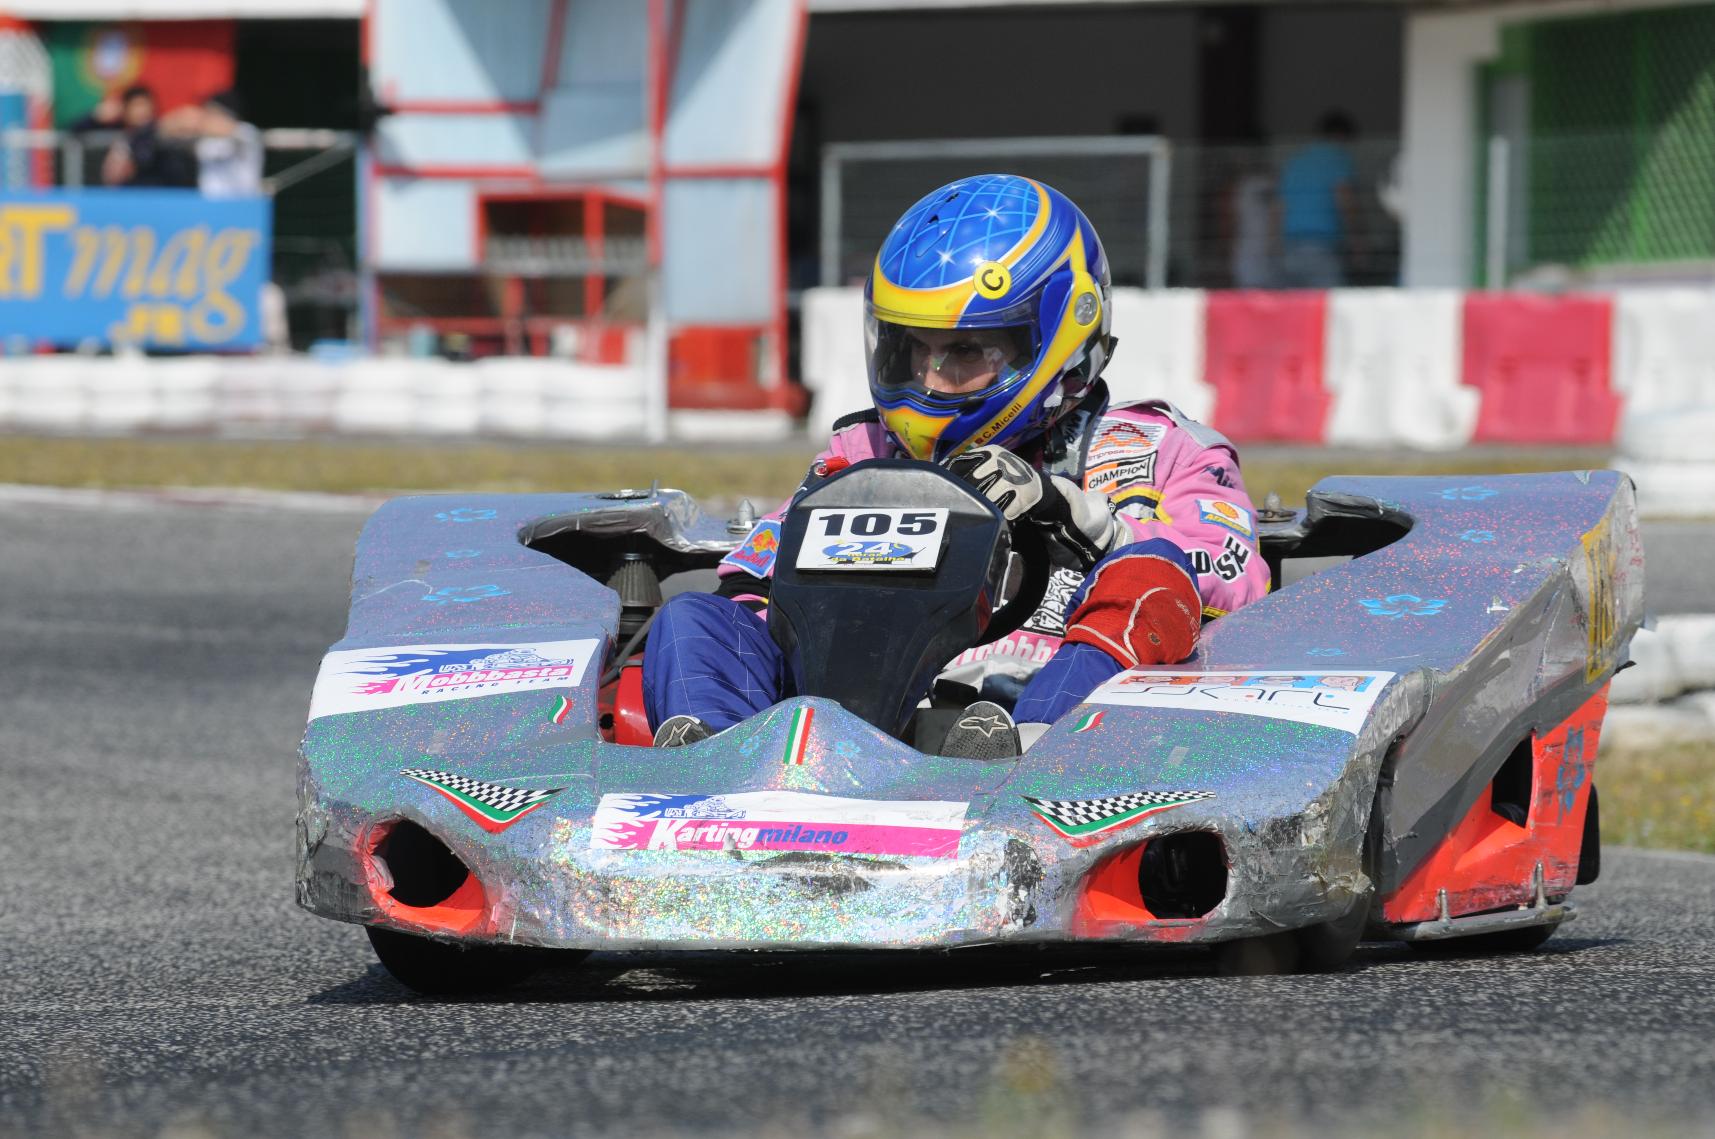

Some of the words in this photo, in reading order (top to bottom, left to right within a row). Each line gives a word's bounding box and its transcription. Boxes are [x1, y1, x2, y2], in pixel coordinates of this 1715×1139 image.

[981, 269, 1004, 291] C
[1088, 462, 1147, 489] CHAMPION
[818, 513, 937, 536] 105
[835, 543, 893, 556] 24
[393, 666, 571, 692] Mobbbasta
[421, 683, 500, 695] RACING
[516, 676, 569, 685] TEAM
